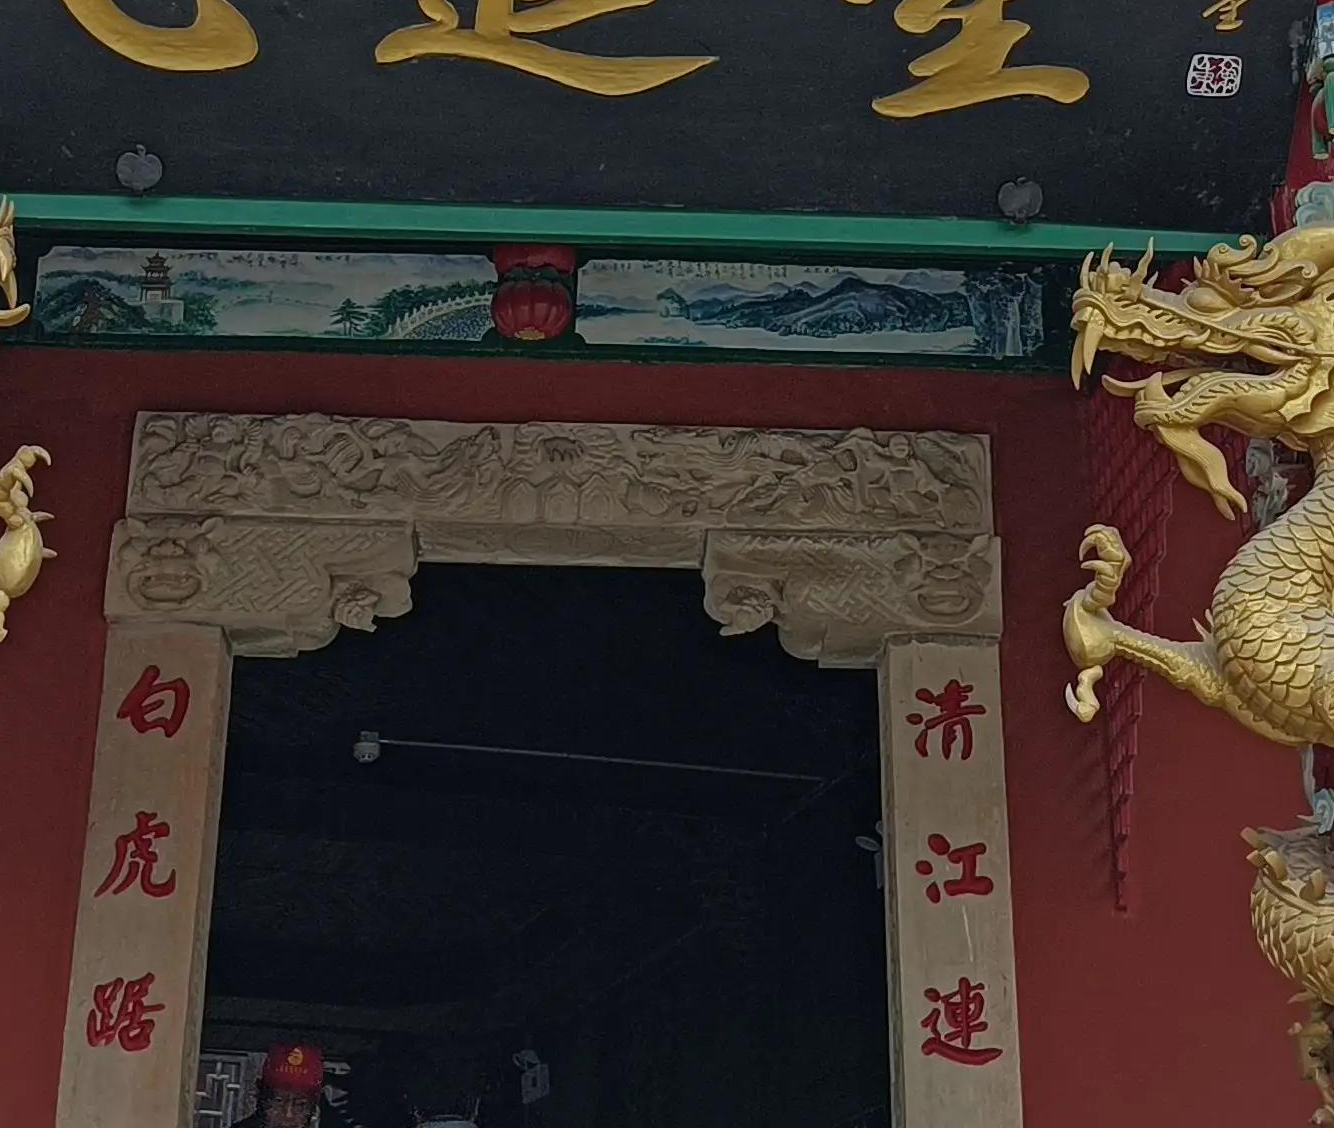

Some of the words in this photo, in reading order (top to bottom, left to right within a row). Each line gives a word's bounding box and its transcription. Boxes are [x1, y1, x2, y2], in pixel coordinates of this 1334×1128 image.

[86, 664, 191, 1052] 白虎踞
[906, 679, 1004, 1066] 清江連
